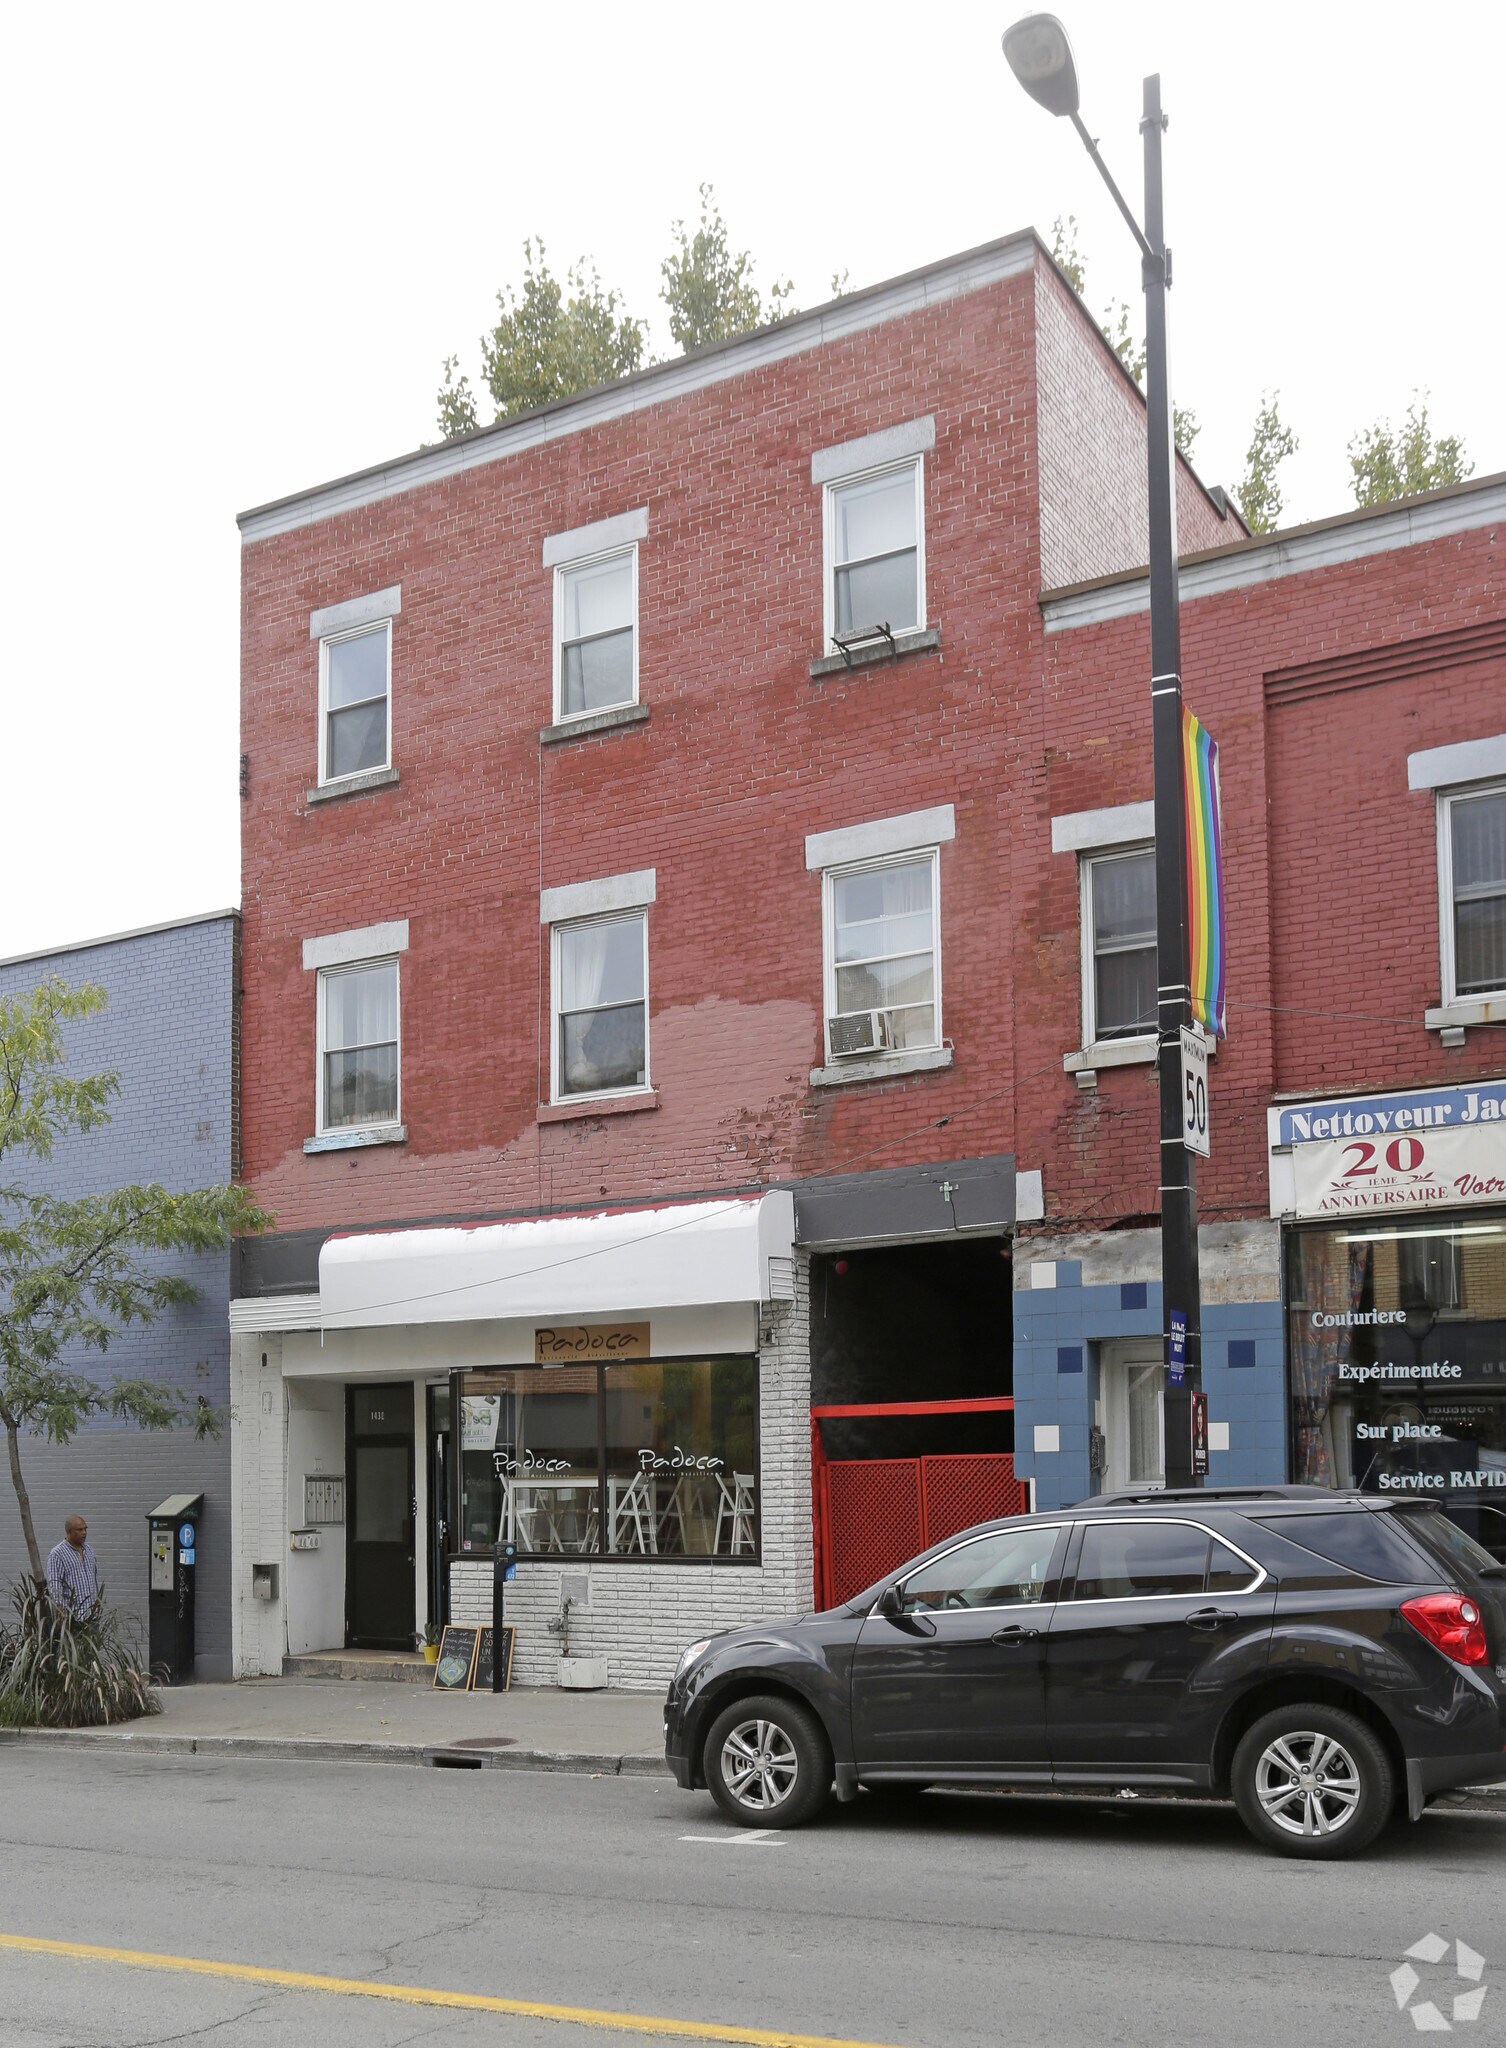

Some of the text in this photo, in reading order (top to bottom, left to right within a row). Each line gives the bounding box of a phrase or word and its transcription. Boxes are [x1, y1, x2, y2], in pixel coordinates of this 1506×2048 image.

[1184, 1038, 1205, 1063] MAXIMUM
[1186, 1069, 1206, 1136] 50
[1290, 1103, 1452, 1141] Nettoyeur
[1341, 1137, 1425, 1178] 20
[1318, 1186, 1449, 1211] ANNIVERSAIRE
[1311, 1308, 1407, 1328] Couturiere
[535, 1326, 639, 1355] Padoca
[1338, 1360, 1462, 1384] Expérimentée
[1356, 1421, 1442, 1443] Sur place
[492, 1448, 572, 1472] Padoca
[637, 1445, 725, 1470] Padoca
[1378, 1471, 1445, 1489] Service
[484, 1630, 509, 1639] VEZ
